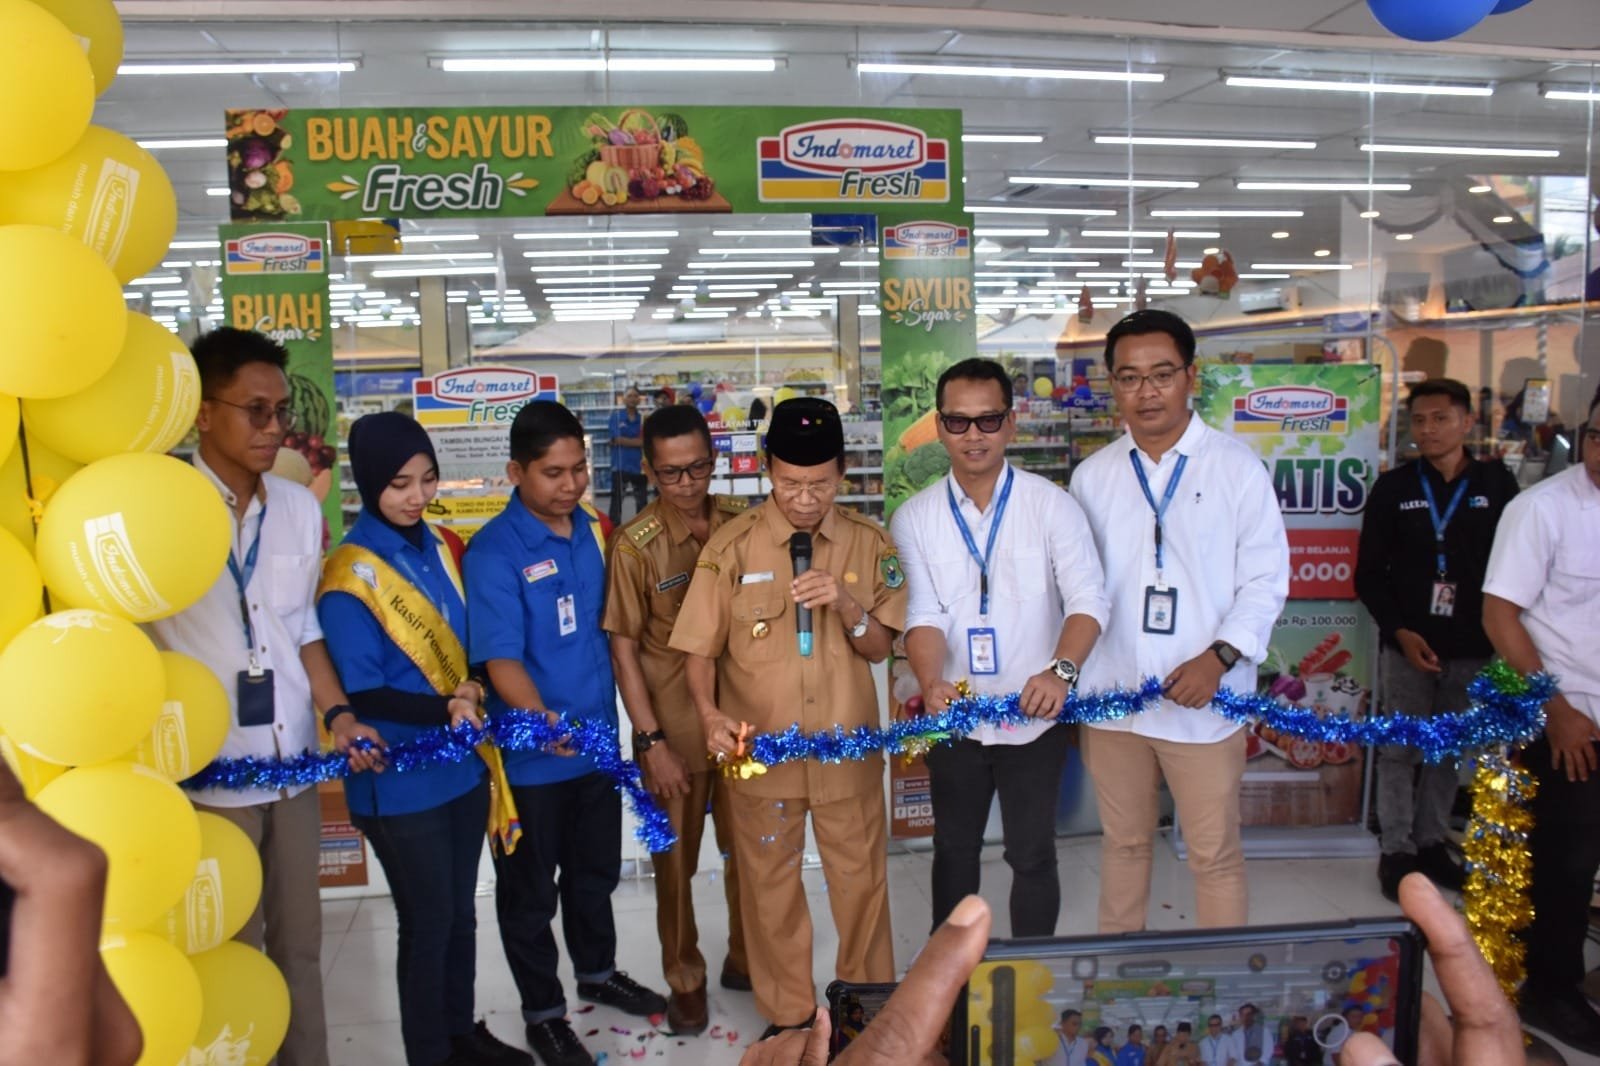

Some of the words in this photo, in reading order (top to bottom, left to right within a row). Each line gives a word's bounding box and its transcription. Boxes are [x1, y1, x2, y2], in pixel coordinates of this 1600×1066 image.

[307, 117, 413, 161] BUAH
[412, 124, 428, 152] &
[427, 115, 554, 158] SAYUR
[793, 135, 915, 160] Indomaret
[363, 164, 503, 211] Fresh
[840, 171, 921, 197] Fresh
[901, 227, 954, 240] Indomaret
[245, 242, 304, 253] Indomaret
[915, 243, 957, 257] Fresh
[263, 257, 308, 271] Fresh
[884, 277, 972, 311] SAYUR
[232, 292, 322, 331] BUAH
[905, 298, 952, 331] Segar
[255, 315, 304, 346] Segar
[441, 378, 531, 394] Indomaret
[469, 400, 531, 421] Fres
[1254, 396, 1329, 410] Indomaret
[1281, 416, 1331, 431] Fresh
[1289, 562, 1351, 581] .000
[390, 594, 426, 632] Kasir
[1291, 615, 1307, 626] Rp
[1311, 615, 1357, 625] 100.000
